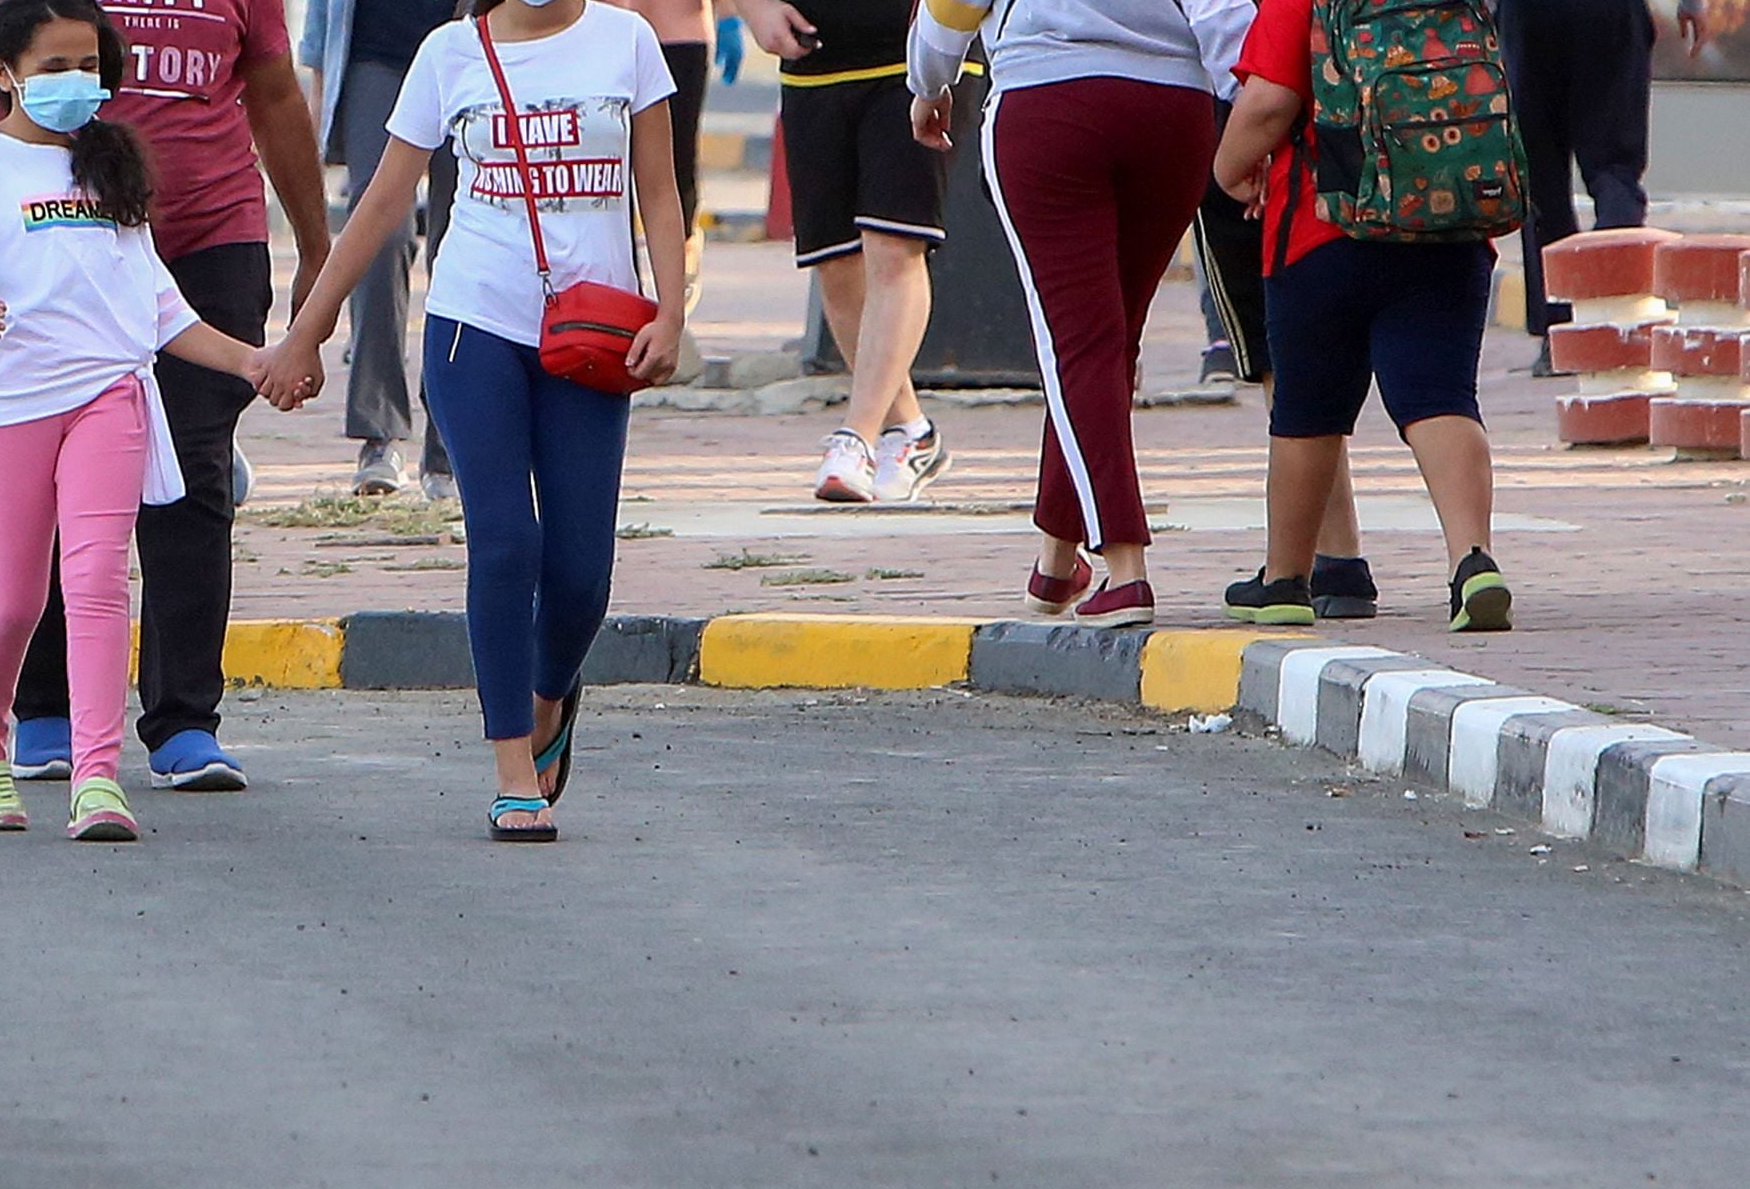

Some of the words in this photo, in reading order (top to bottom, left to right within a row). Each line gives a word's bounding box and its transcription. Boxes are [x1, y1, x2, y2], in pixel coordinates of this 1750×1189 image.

[123, 16, 161, 28] THERE
[168, 17, 180, 29] IS
[130, 45, 222, 86] TORY
[543, 164, 569, 193] TO
[572, 163, 622, 193] WEAR
